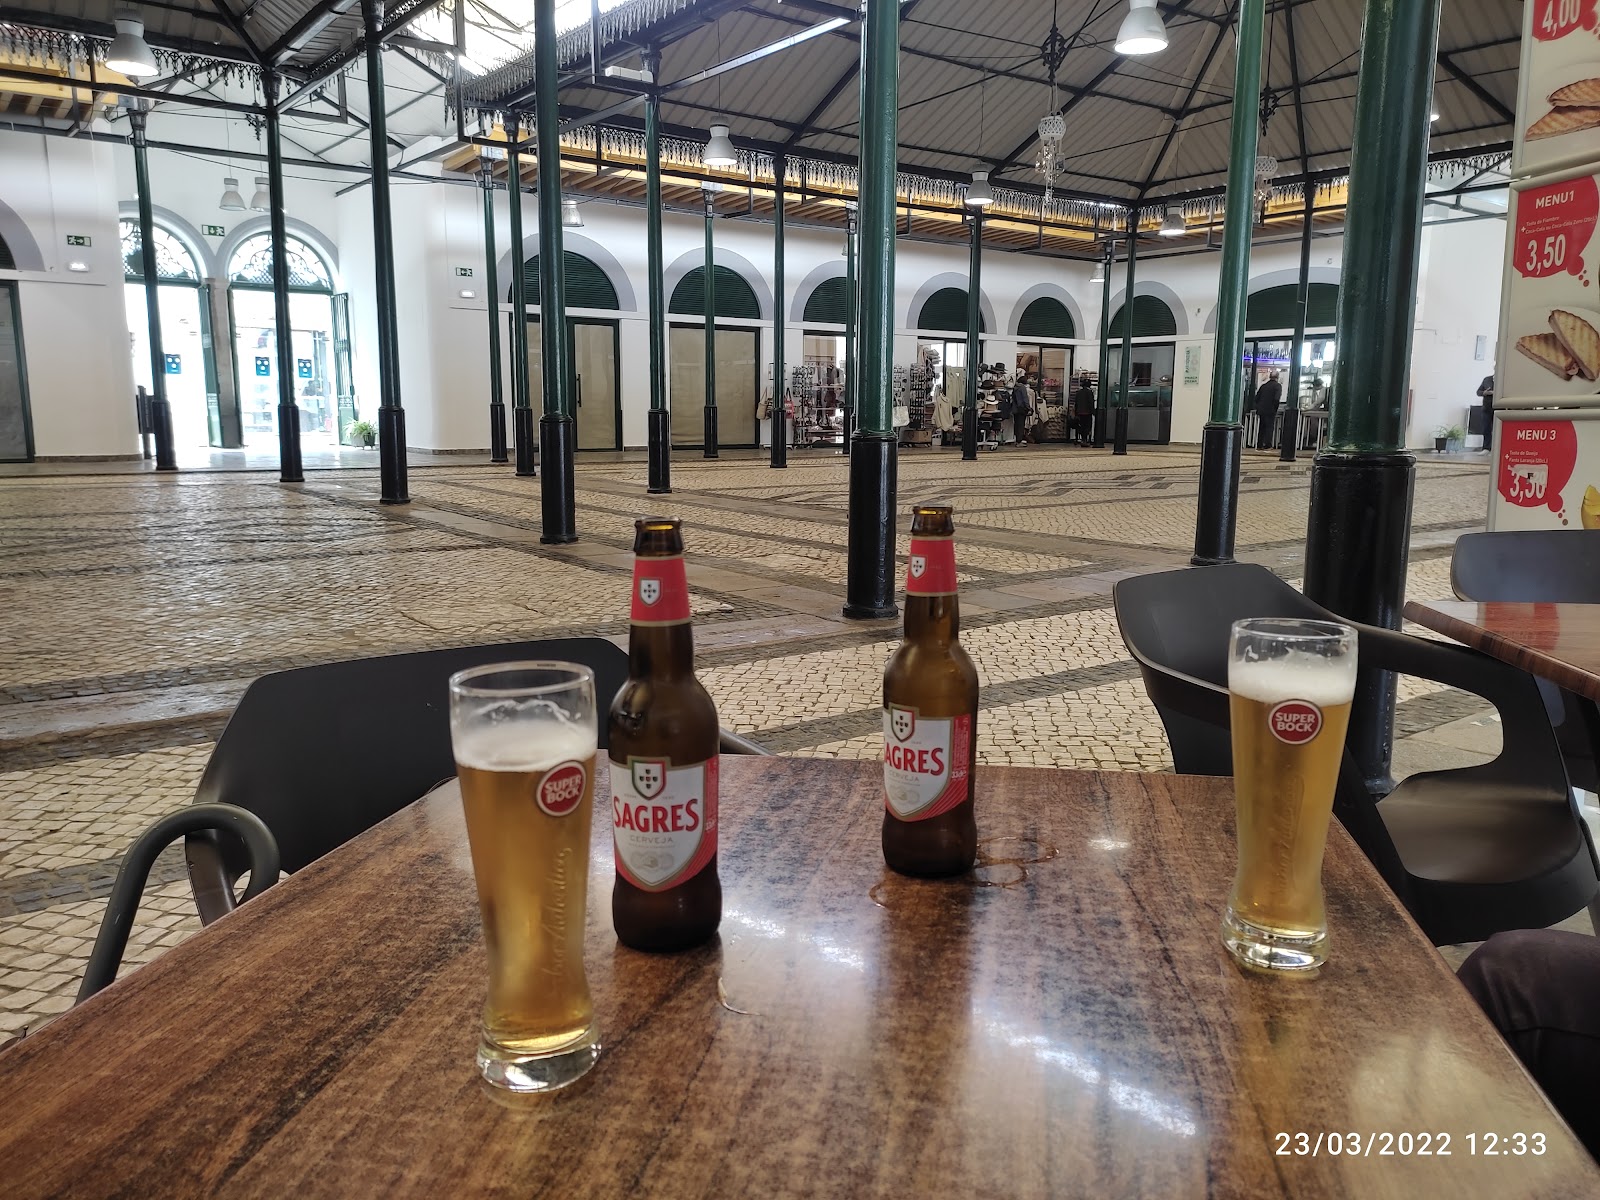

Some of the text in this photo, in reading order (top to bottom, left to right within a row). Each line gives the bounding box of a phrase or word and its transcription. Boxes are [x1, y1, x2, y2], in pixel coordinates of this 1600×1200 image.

[1542, 0, 1581, 37] 4,00
[1526, 234, 1566, 276] 3,50
[1516, 429, 1557, 441] MENU 3
[1275, 712, 1316, 723] SUPER
[1277, 721, 1313, 732] BOCK
[885, 741, 945, 776] AGRES
[545, 774, 581, 793] SUPER
[546, 788, 579, 804] BOCK
[613, 796, 699, 833] SAGRES
[630, 834, 674, 844] CERVEJA
